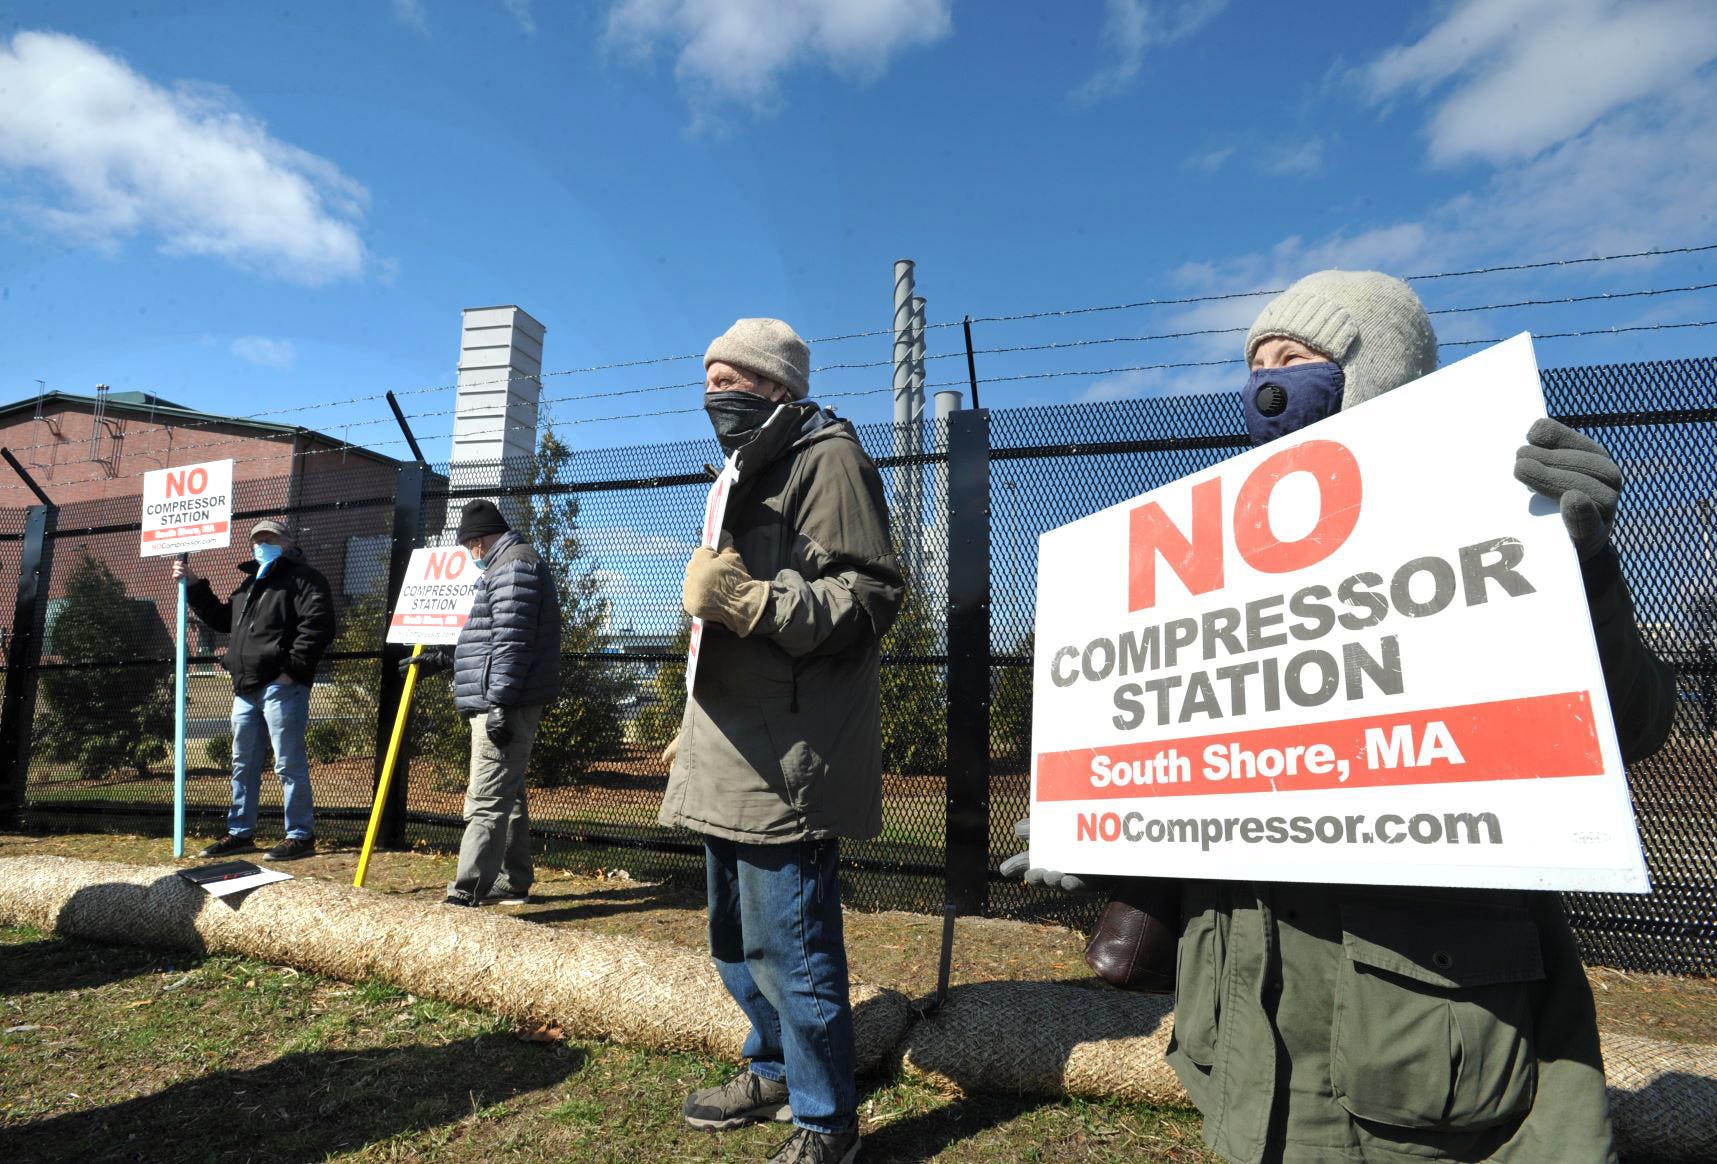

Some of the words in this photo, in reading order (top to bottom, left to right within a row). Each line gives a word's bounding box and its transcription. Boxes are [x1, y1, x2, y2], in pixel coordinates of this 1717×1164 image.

[165, 467, 209, 499] NO
[146, 495, 226, 515] COMPRESSOR
[160, 510, 210, 526] STATION
[1128, 439, 1363, 613] NO
[423, 550, 467, 581] NO
[403, 584, 475, 597] COMPRESSOR
[411, 598, 458, 611] STATION
[1050, 535, 1537, 688] COMPRESSOR
[1112, 634, 1404, 731] STATION
[1089, 748, 1192, 788] South
[1202, 742, 1350, 783] Shore,
[1364, 720, 1466, 771] MA
[1077, 811, 1504, 852] NOCompressor.com
